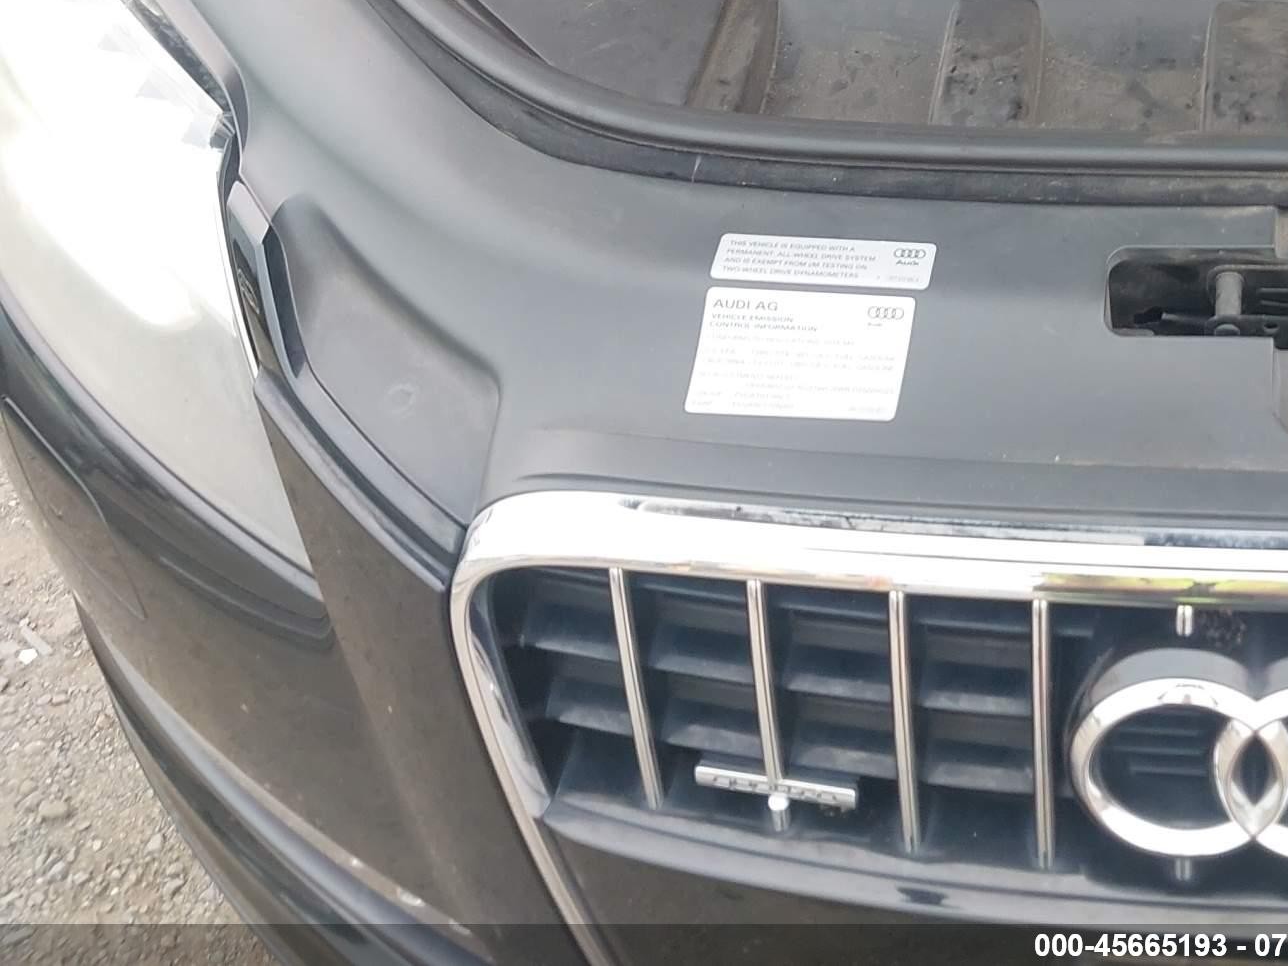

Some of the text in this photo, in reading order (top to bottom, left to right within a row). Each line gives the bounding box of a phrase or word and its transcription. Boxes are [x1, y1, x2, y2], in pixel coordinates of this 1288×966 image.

[790, 242, 827, 250] EQUIPPED
[724, 256, 741, 264] AND
[845, 254, 876, 262] SYSTEM
[713, 298, 779, 312] AUDI AG
[712, 313, 793, 323] VEHICLE EMISSION
[709, 321, 818, 332] CONTROL INFORMATION
